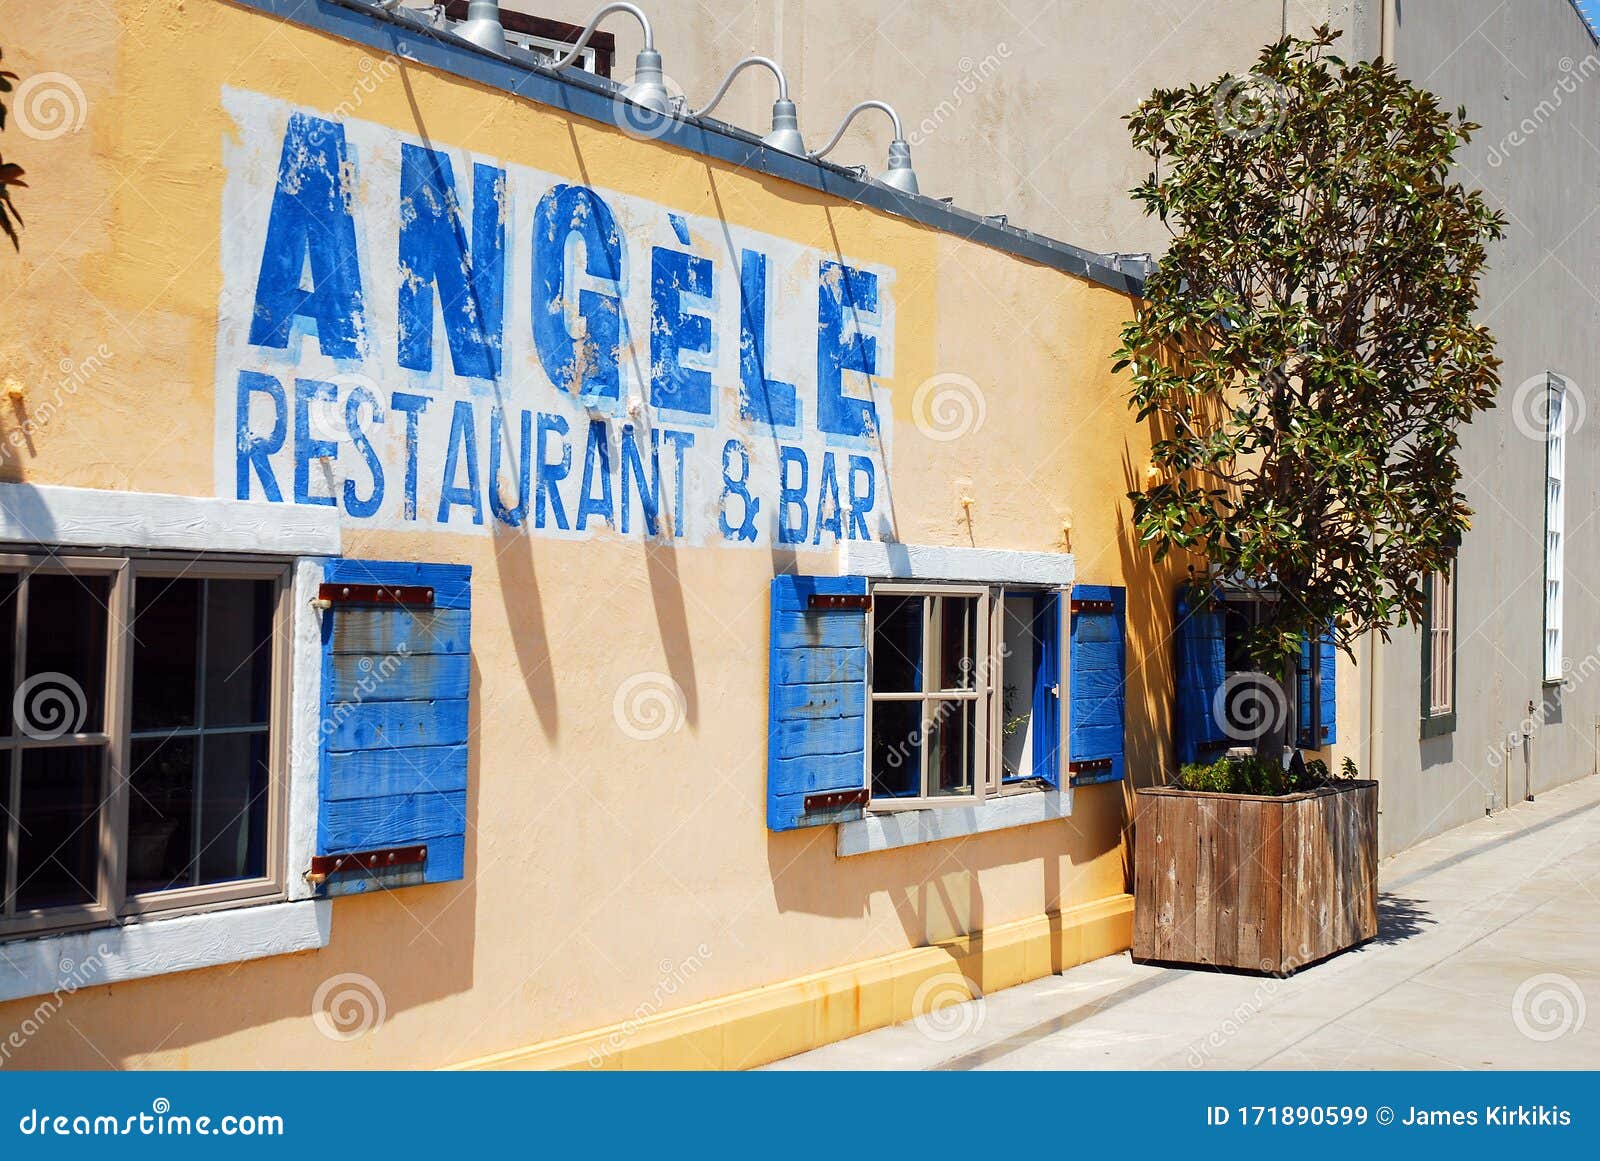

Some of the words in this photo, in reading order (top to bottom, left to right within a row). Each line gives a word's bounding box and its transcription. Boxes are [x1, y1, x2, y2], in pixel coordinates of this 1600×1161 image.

[248, 111, 878, 438] ANGÈLE
[236, 369, 695, 538] RESTAURANT
[718, 439, 760, 544] &
[778, 445, 876, 545] BAR
